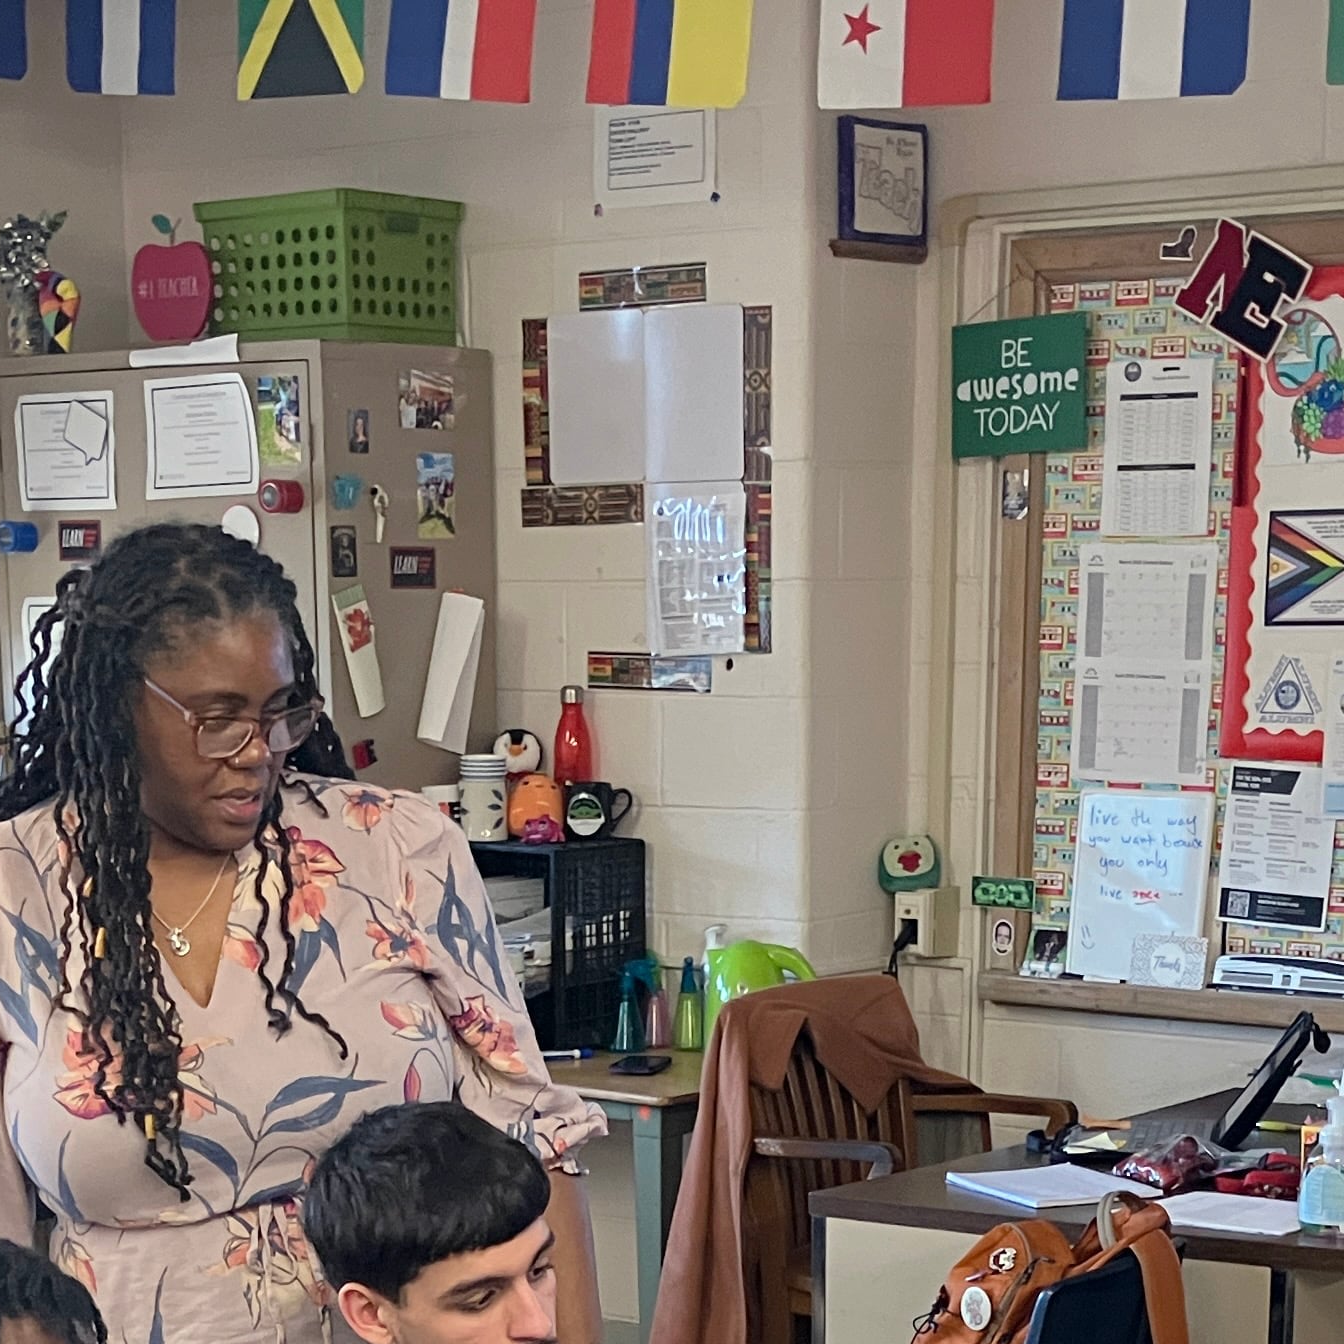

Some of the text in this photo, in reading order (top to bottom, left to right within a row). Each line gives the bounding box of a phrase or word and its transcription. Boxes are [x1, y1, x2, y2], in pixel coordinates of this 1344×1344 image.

[1001, 337, 1033, 369] BE
[956, 367, 1079, 402] awesome
[973, 400, 1061, 437] TODAY
[1167, 815, 1198, 836] way
[1088, 836, 1111, 851] you
[1099, 850, 1168, 876] you only
[1099, 885, 1123, 900] live
